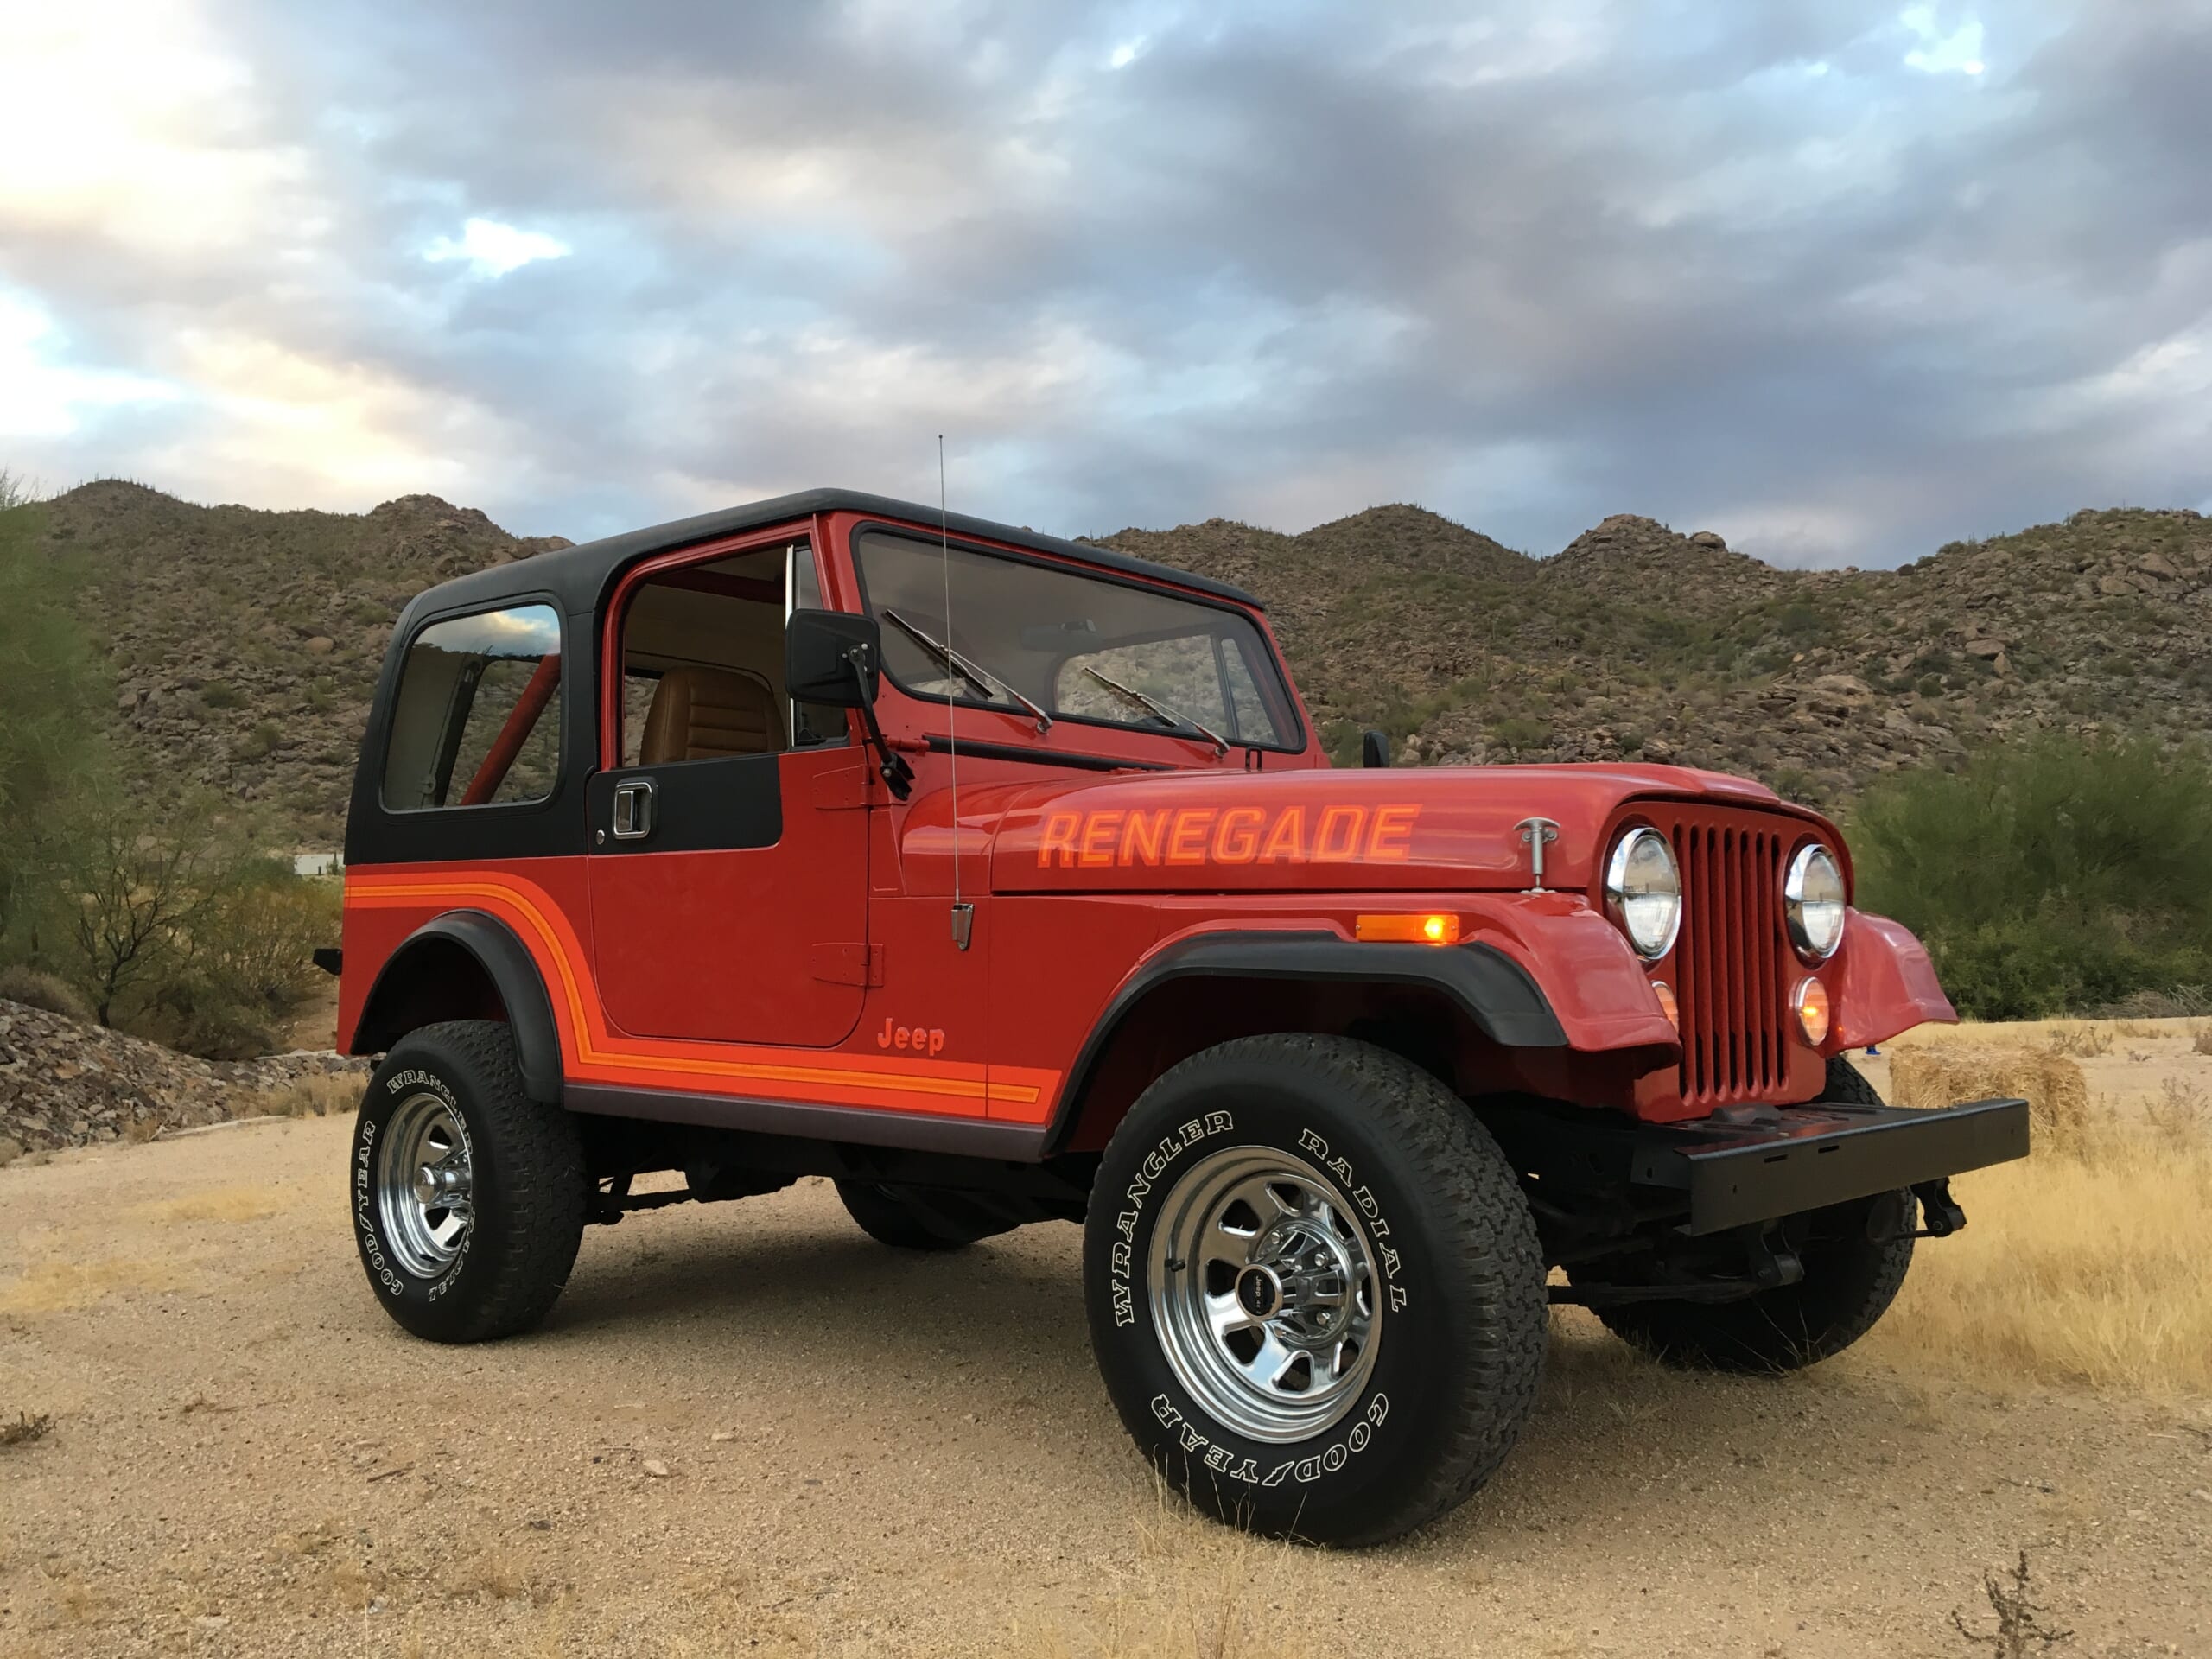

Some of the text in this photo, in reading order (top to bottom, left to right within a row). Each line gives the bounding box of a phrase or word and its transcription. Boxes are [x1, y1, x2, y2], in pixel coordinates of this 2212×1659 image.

[1037, 804, 1422, 868] RENEGADE
[877, 1017, 945, 1057] Jeep
[1112, 1110, 1233, 1326] WRANGLER
[1298, 1128, 1407, 1312] RADIAL
[1151, 1392, 1389, 1486] GOODYEAR
